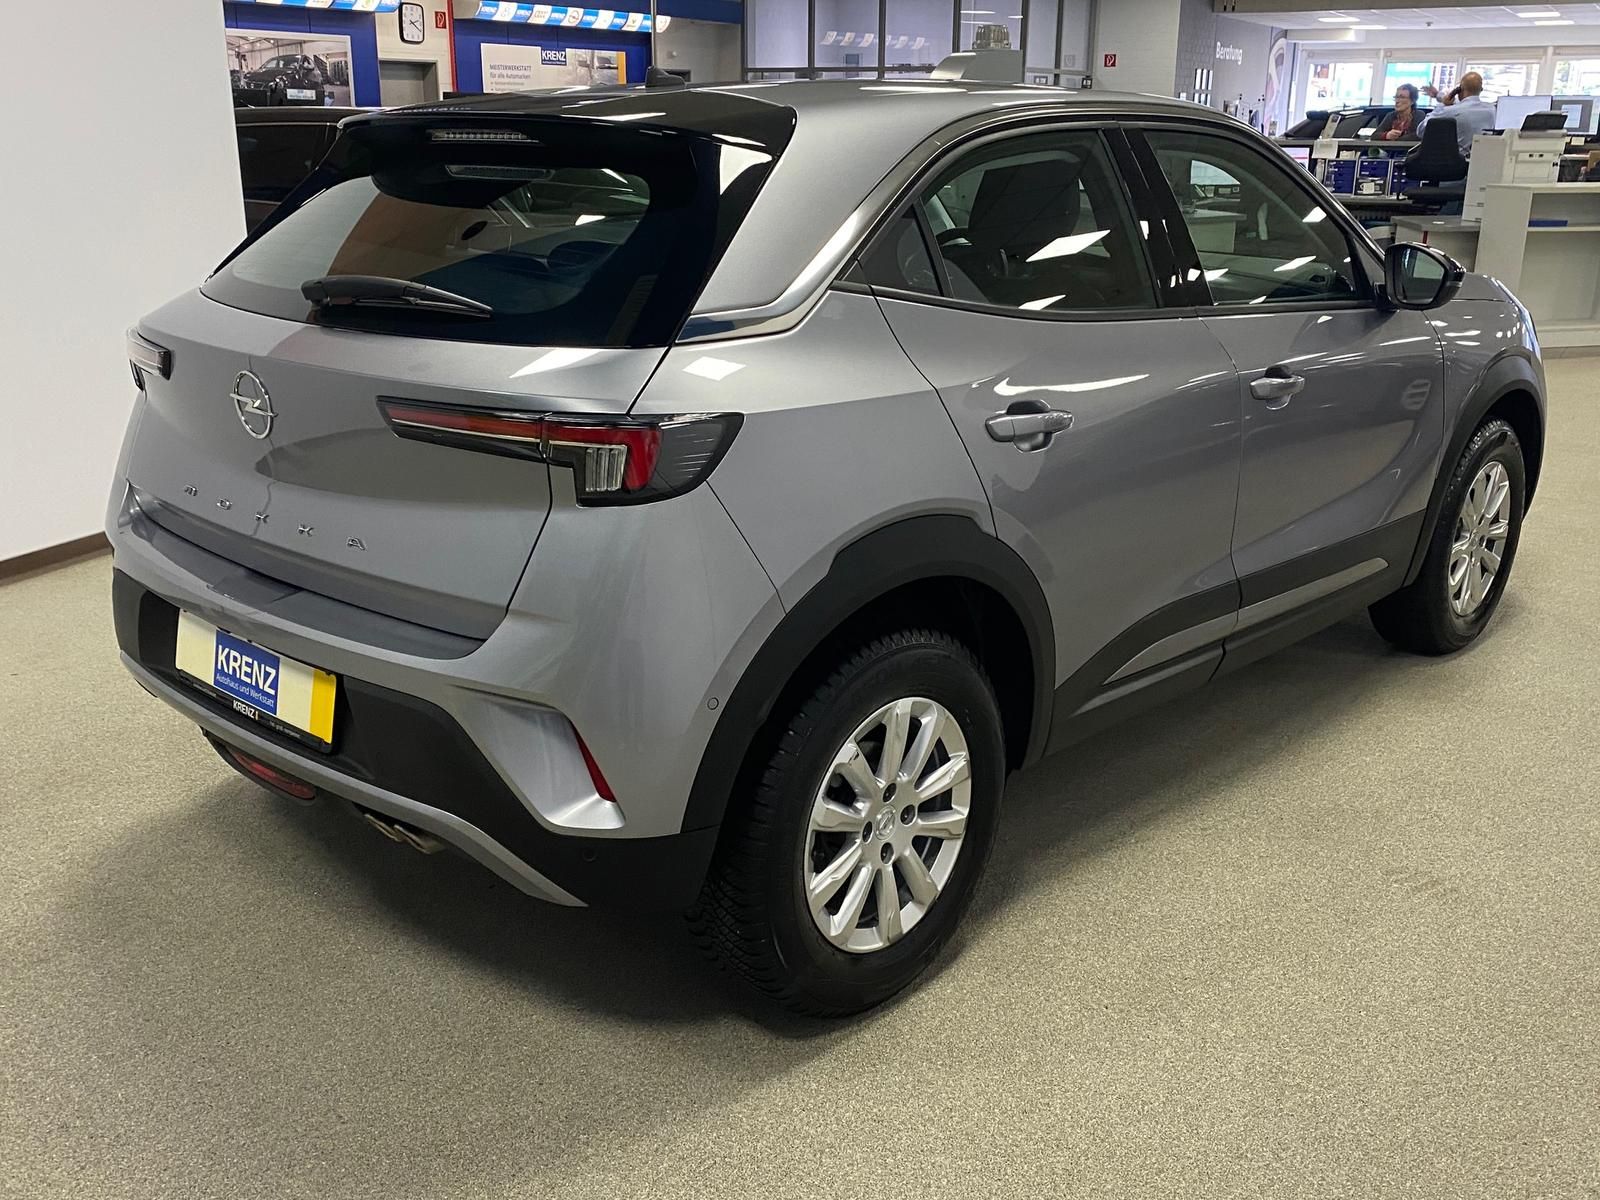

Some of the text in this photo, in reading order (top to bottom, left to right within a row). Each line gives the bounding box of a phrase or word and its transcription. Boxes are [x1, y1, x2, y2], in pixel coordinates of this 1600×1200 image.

[541, 50, 566, 61] KRENZ
[1216, 41, 1243, 65] Beratung
[217, 645, 277, 695] KRENZ
[216, 673, 239, 691] Autohaus
[239, 684, 250, 696] und
[250, 690, 274, 708] Werkstatt
[233, 699, 256, 719] KRENZ
